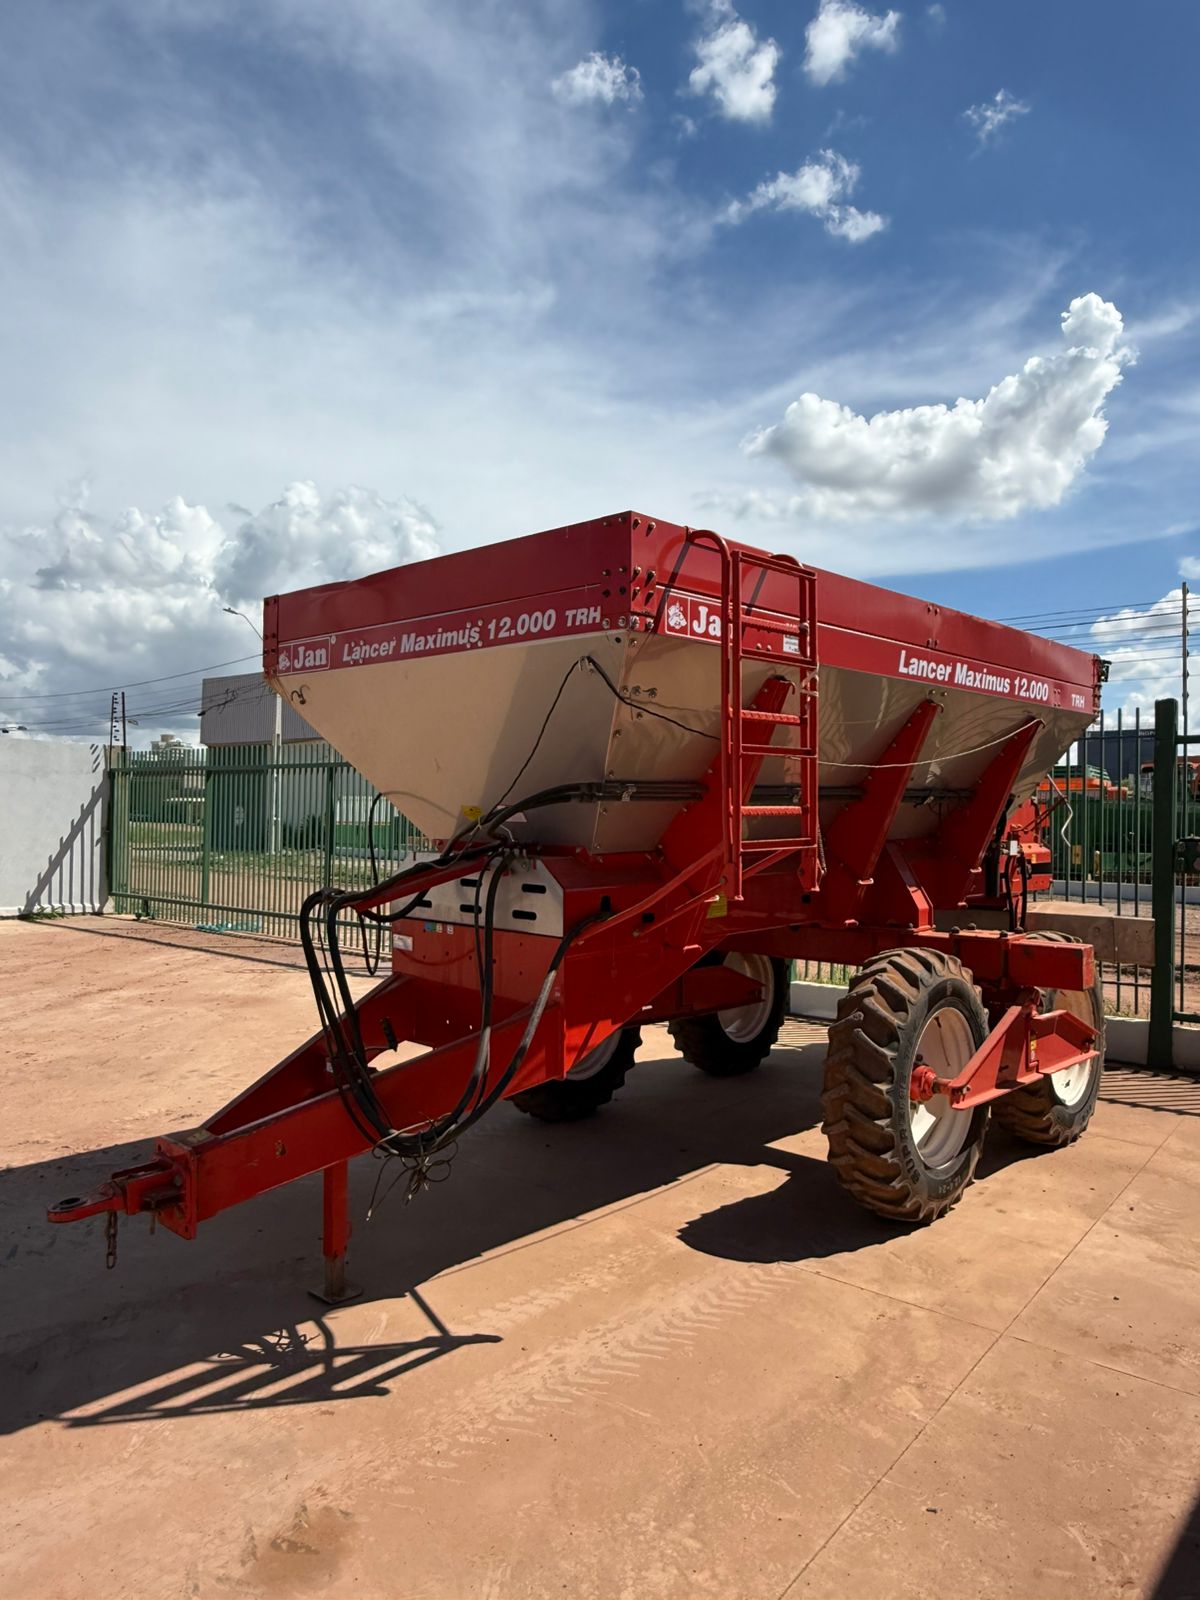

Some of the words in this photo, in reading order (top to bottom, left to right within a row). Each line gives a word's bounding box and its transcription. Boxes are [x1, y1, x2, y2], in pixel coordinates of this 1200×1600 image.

[293, 646, 327, 669] Jan
[341, 640, 396, 663] Lancer
[400, 625, 480, 653] Maximus
[487, 608, 556, 640] 12.000
[565, 606, 601, 627] TRH
[898, 650, 952, 682] Lancer
[954, 662, 1010, 693] Maximus
[1014, 676, 1049, 701] 12.000
[1071, 693, 1086, 708] TRH
